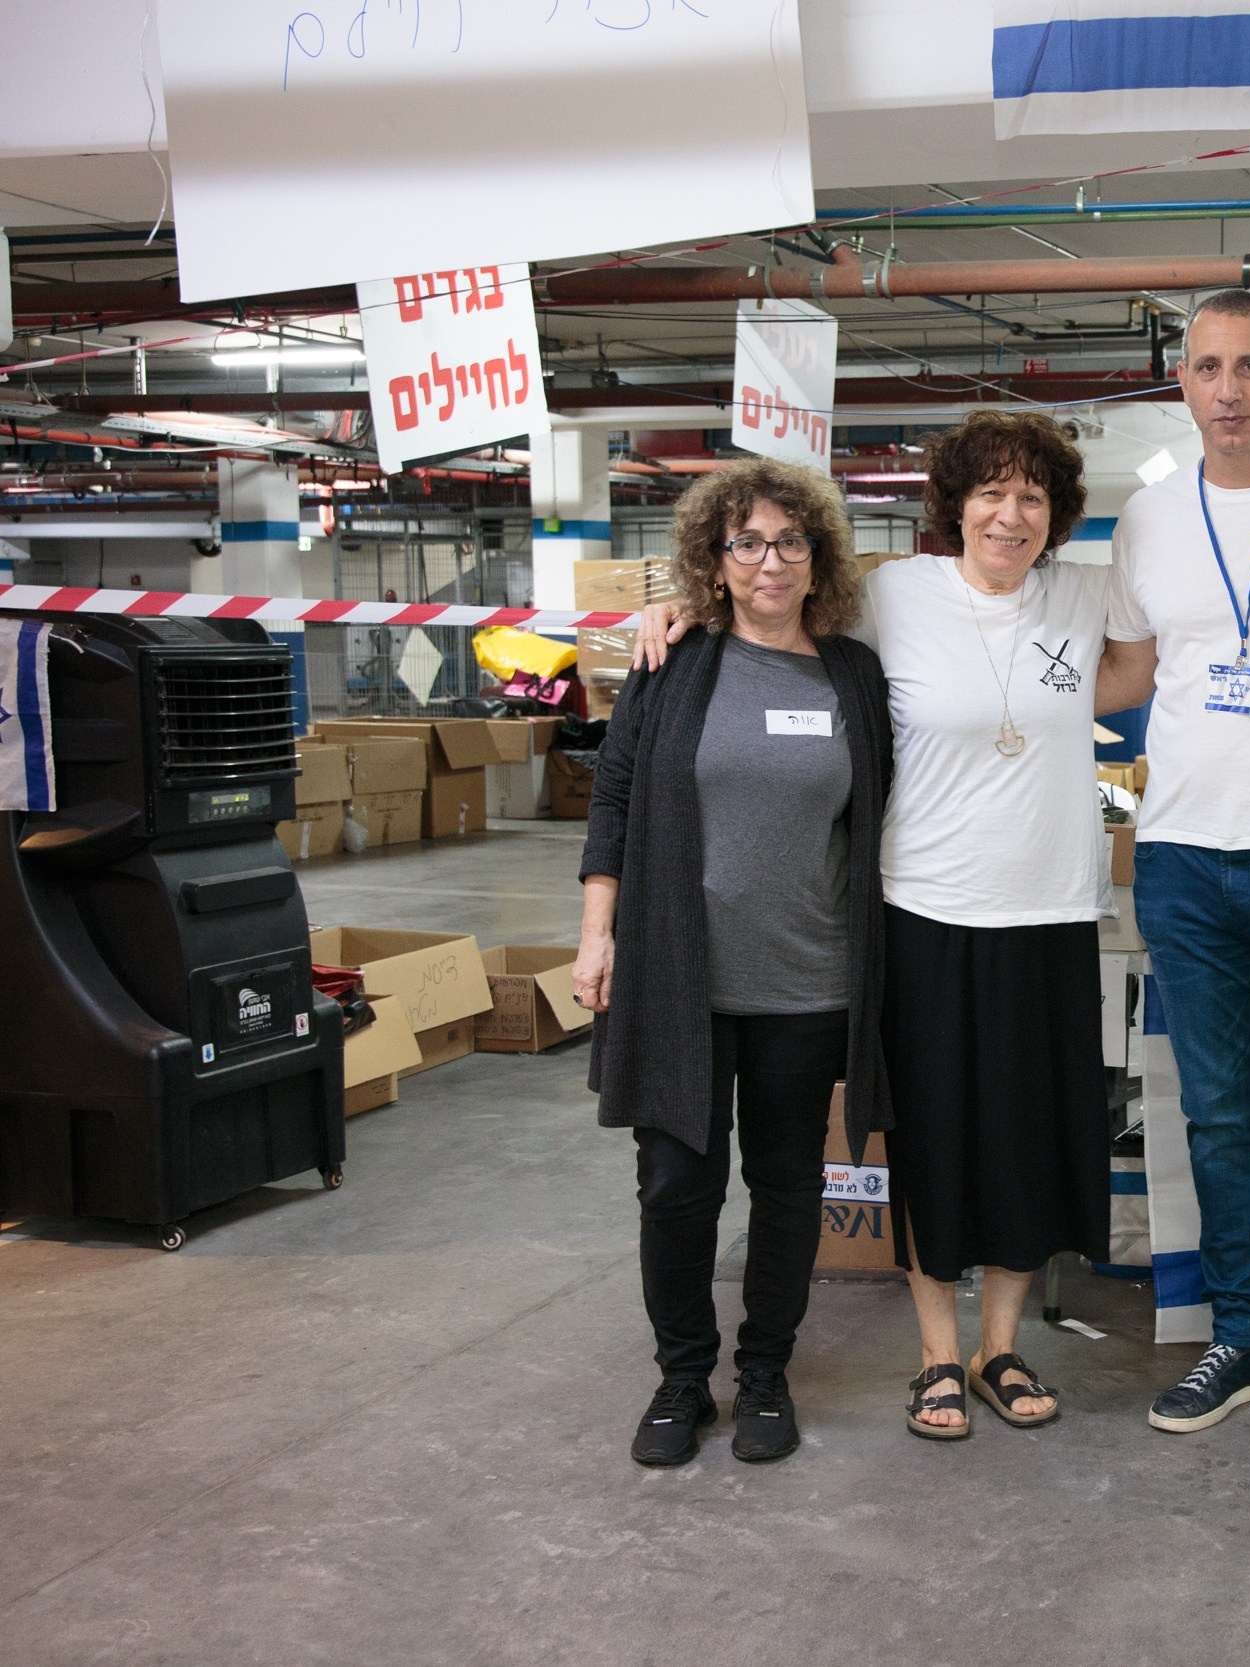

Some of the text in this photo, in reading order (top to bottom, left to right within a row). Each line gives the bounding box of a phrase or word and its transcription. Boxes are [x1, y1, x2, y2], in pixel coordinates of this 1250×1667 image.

[393, 266, 504, 323] בגדים
[388, 338, 530, 432] לחיילים
[741, 385, 828, 457] חיילים
[1053, 682, 1078, 693] ברזל
[239, 1001, 272, 1020] החוויה
[832, 1171, 850, 1182] לשון
[846, 1183, 858, 1193] לא
